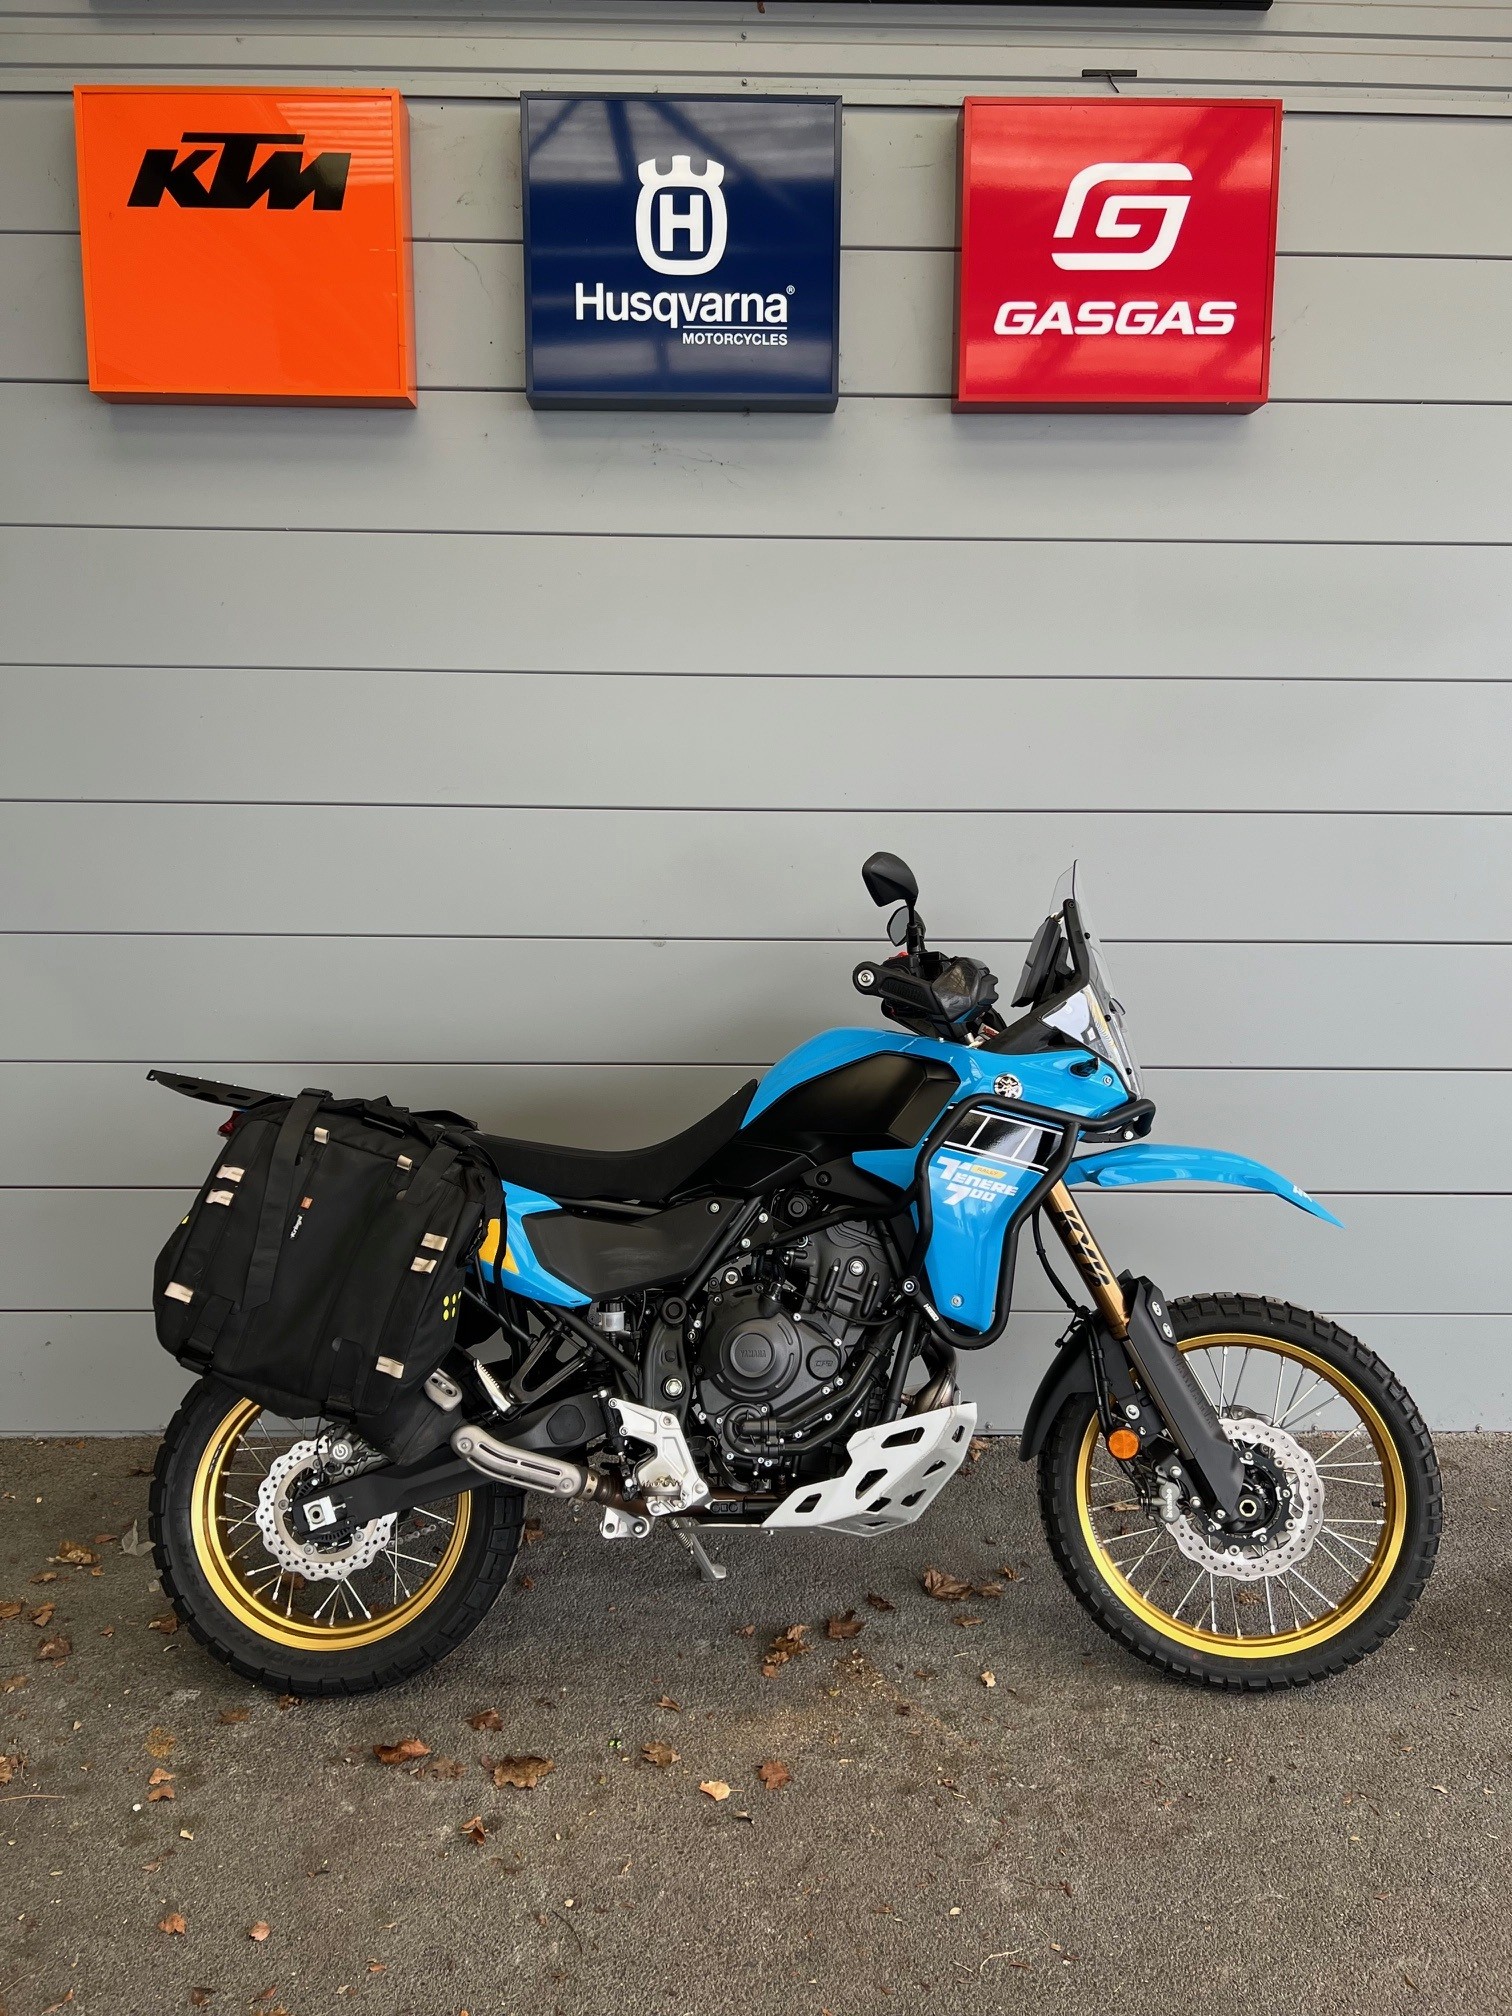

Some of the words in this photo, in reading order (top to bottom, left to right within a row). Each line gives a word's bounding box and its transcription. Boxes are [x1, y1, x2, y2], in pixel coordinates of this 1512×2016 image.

[127, 131, 352, 211] KTM
[993, 301, 1238, 336] GASGAS
[682, 332, 788, 346] MOTORCYCLES
[942, 1182, 998, 1206] 700
